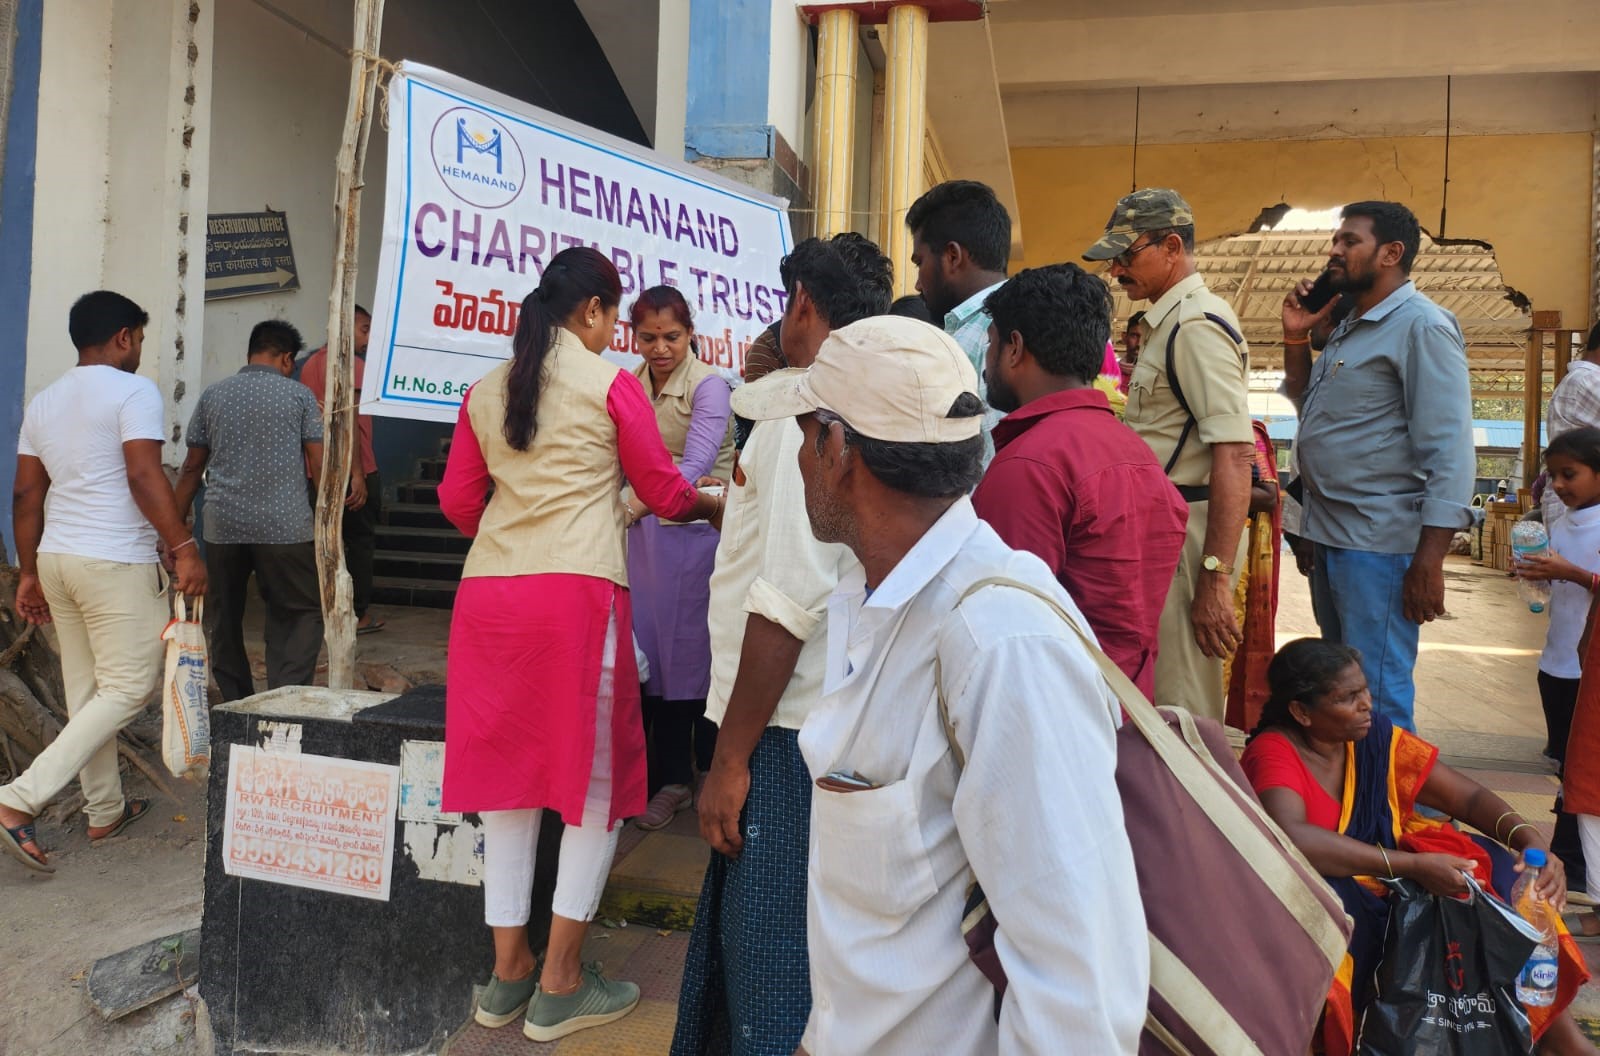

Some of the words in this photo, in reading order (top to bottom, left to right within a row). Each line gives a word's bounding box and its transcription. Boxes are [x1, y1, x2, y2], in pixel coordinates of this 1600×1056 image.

[443, 165, 517, 192] HEMANAND
[540, 157, 739, 257] HEMANAND
[208, 218, 260, 235] RESERVATION
[260, 217, 285, 232] OFFICE
[415, 202, 678, 297] CHARIBLE
[689, 266, 788, 324] TRUST
[240, 793, 263, 805] RW
[269, 797, 382, 824] RECRUITMENT
[1438, 1018, 1462, 1033] SINCE
